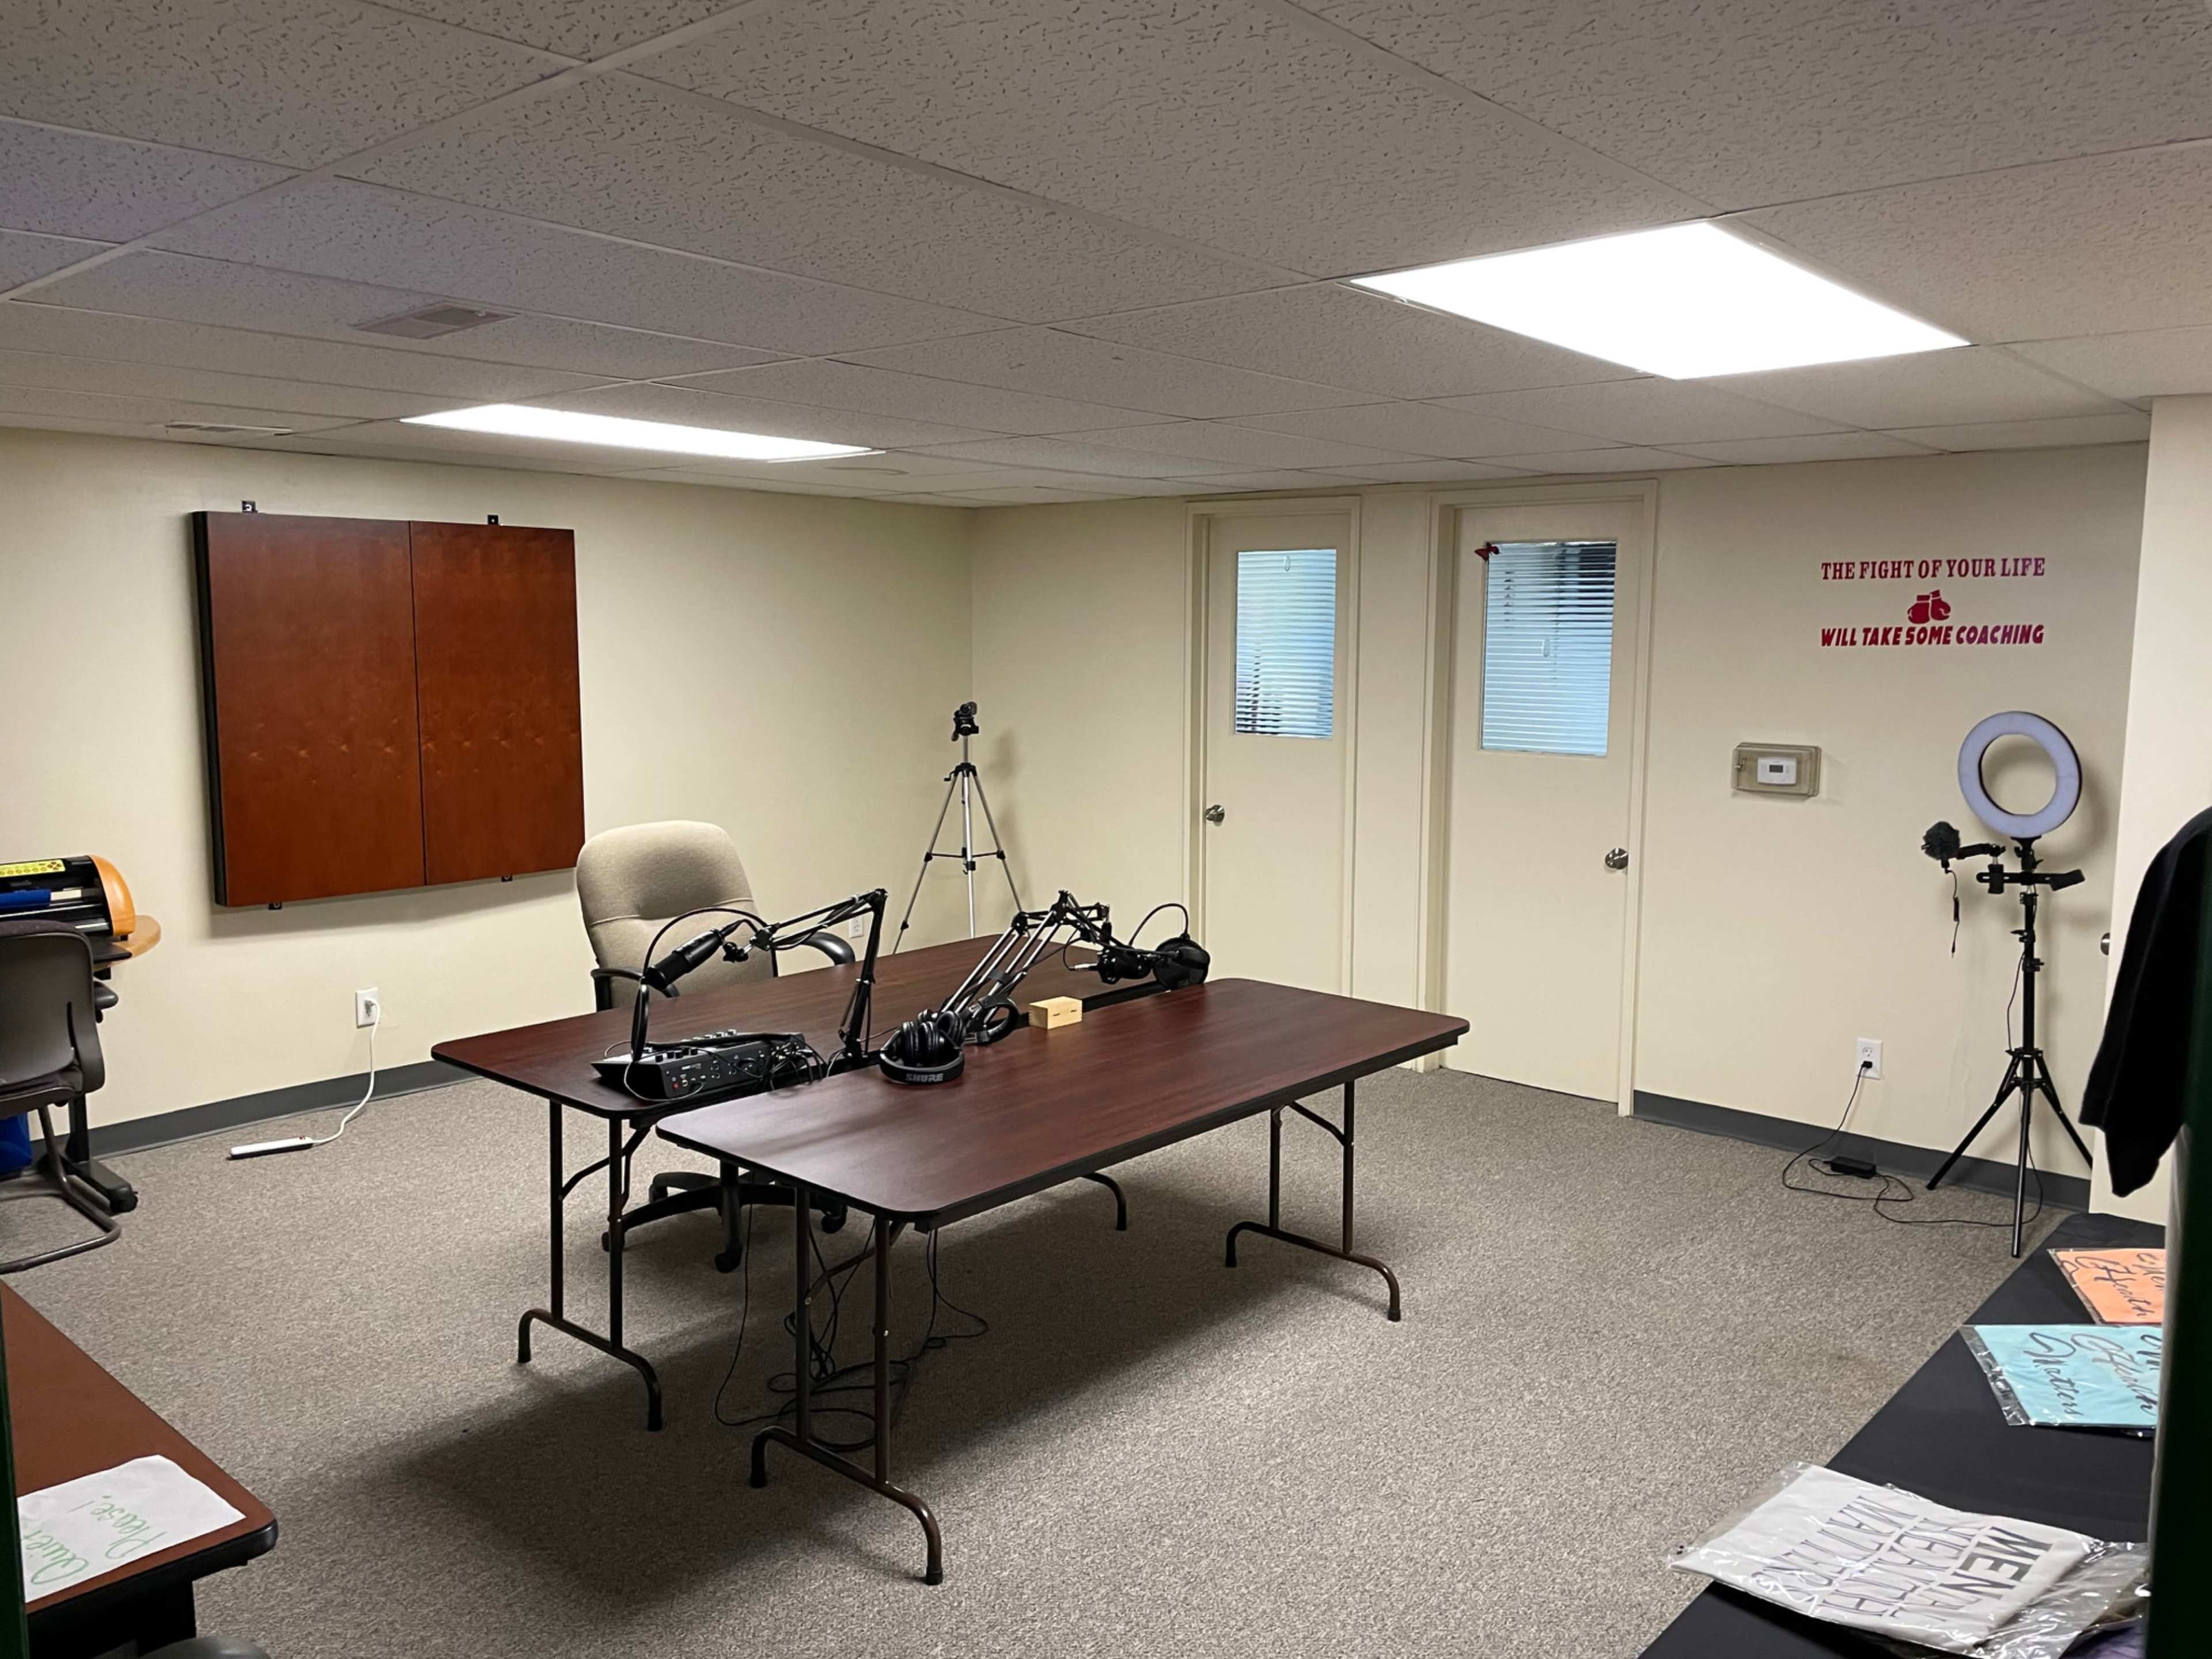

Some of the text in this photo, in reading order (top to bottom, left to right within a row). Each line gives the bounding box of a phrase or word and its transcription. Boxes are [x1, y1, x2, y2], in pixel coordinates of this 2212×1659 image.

[1821, 557, 2046, 580] THE FIGHT OF YOUR LIFE
[1821, 624, 2044, 646] WILL TAKE SOME COACHING
[905, 1073, 944, 1082] SHURE
[2023, 1332, 2084, 1416] Matters
[21, 1529, 90, 1585] Quiet
[1751, 1495, 1918, 1603] MATTERS
[1816, 1517, 1988, 1618] HEALTH
